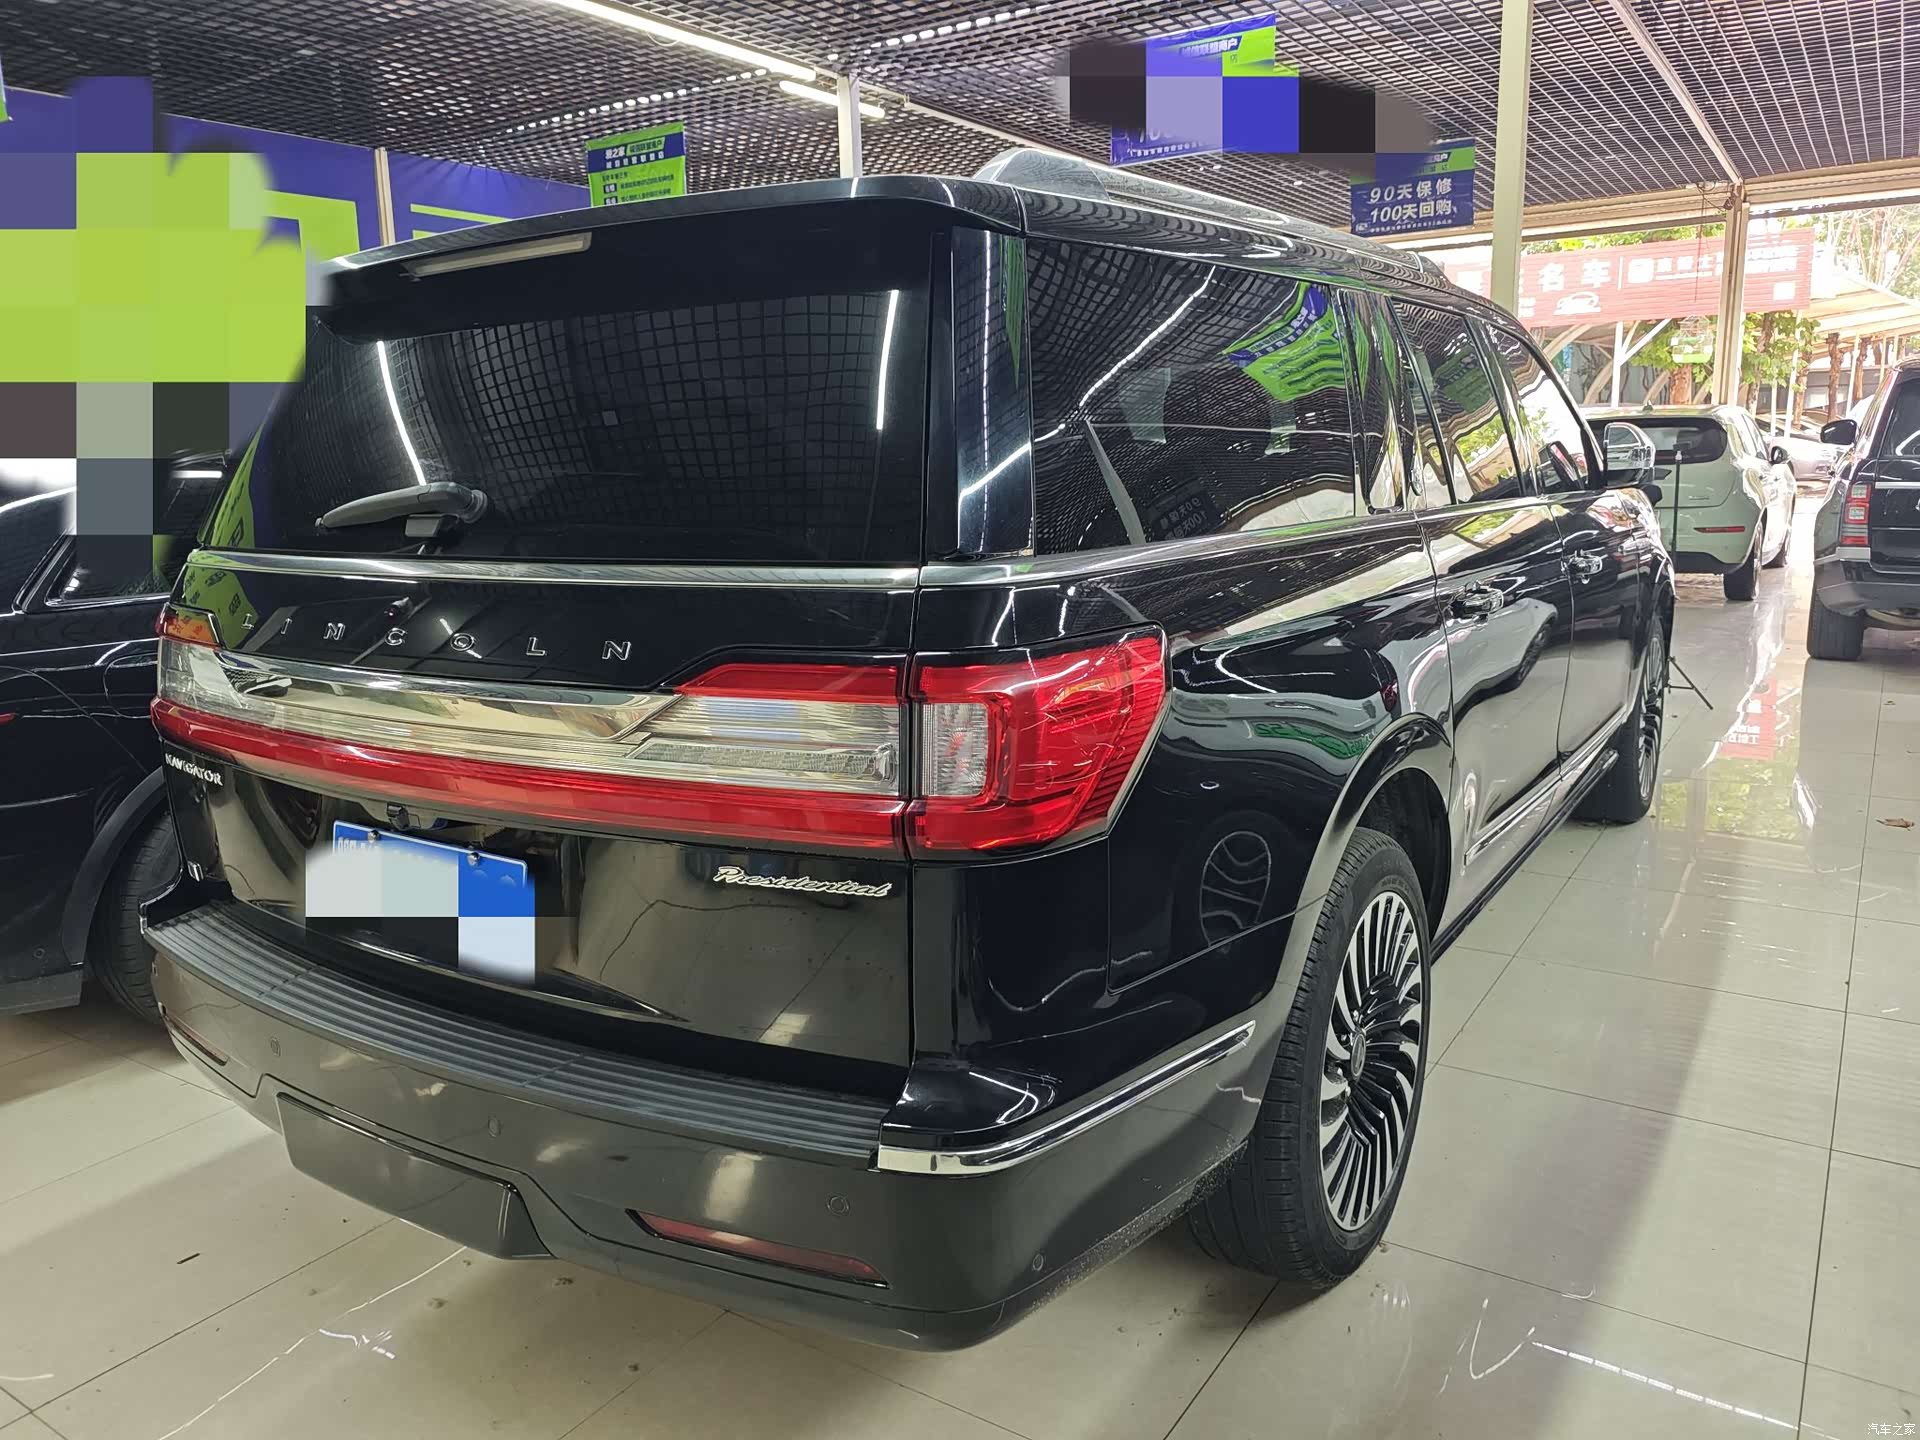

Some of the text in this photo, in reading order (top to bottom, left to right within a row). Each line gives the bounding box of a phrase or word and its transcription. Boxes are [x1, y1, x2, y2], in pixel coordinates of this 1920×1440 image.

[1370, 177, 1452, 204] 90天保修
[1370, 199, 1452, 223] 100天回购
[243, 613, 632, 660] LINCOLN
[165, 753, 223, 786] NAVIGATOR
[713, 865, 892, 897] Presidential
